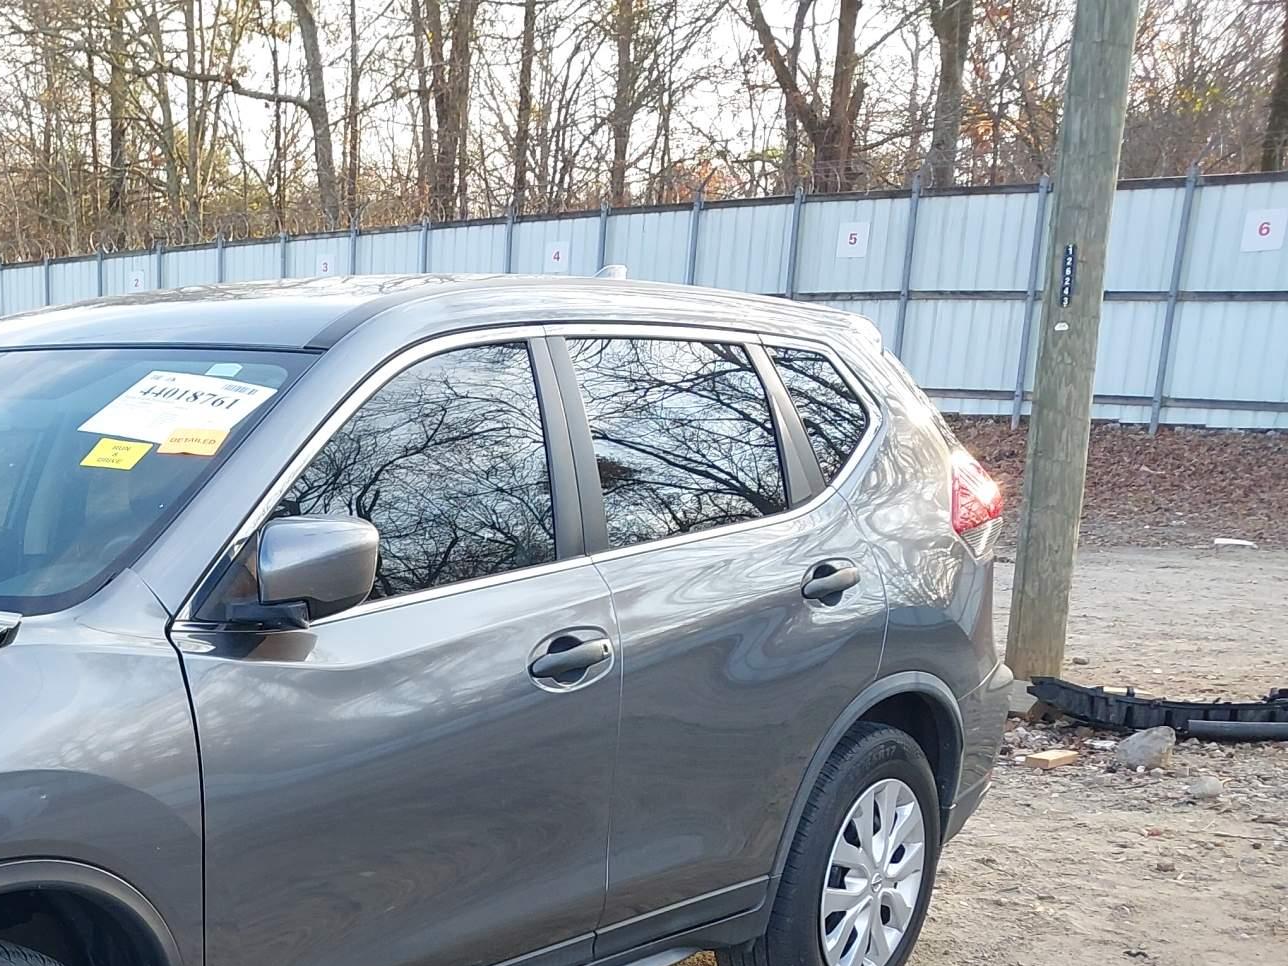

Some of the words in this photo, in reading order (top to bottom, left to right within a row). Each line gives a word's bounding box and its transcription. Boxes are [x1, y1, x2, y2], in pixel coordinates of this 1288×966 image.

[1259, 221, 1271, 236] 6
[848, 232, 858, 245] 5
[553, 250, 560, 262] 4
[322, 262, 328, 273] 3
[1063, 244, 1073, 305] 126243
[134, 278, 140, 288] 2
[139, 384, 242, 410] 44018761
[169, 437, 217, 445] DETAILED
